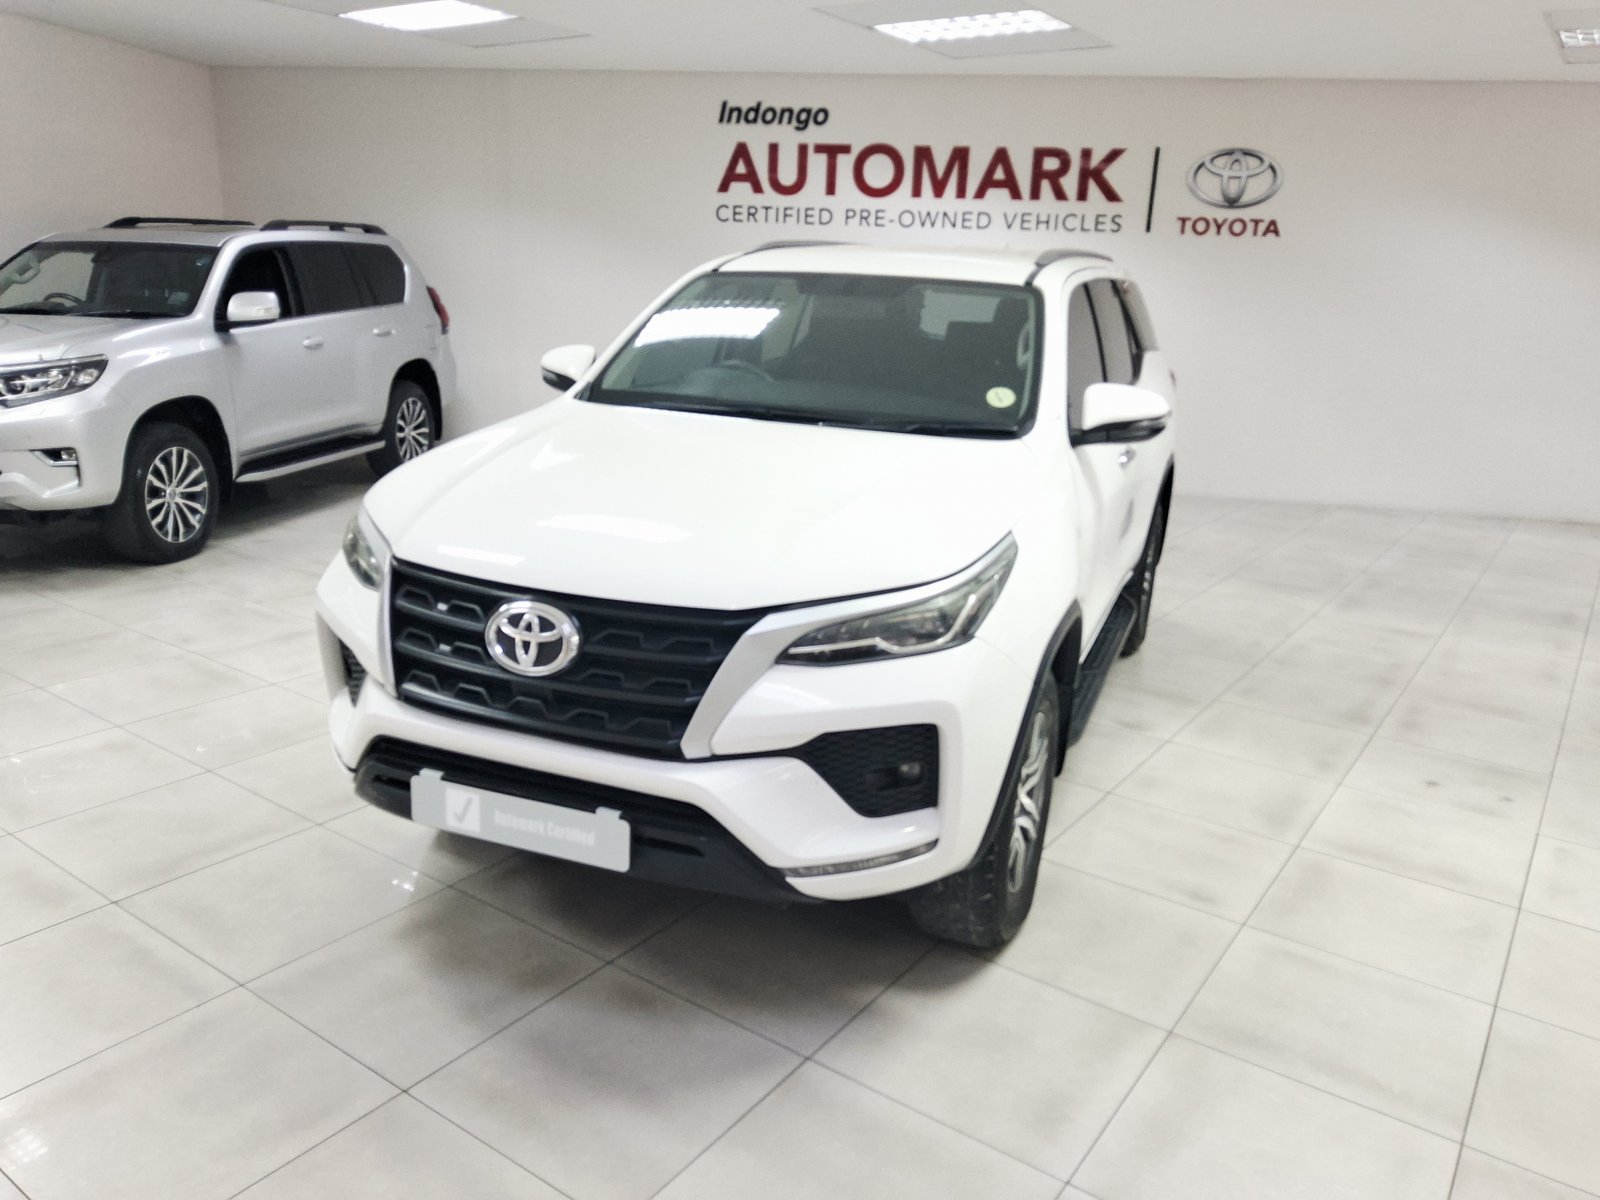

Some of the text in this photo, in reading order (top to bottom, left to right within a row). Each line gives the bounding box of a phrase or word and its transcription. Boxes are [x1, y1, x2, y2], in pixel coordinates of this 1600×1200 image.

[718, 100, 829, 131] Indongo
[718, 141, 1126, 202] AUTOMARK
[716, 204, 1123, 233] CERTIFIED PRE-OWNED VEHICLES
[1177, 216, 1281, 237] TOYOTA
